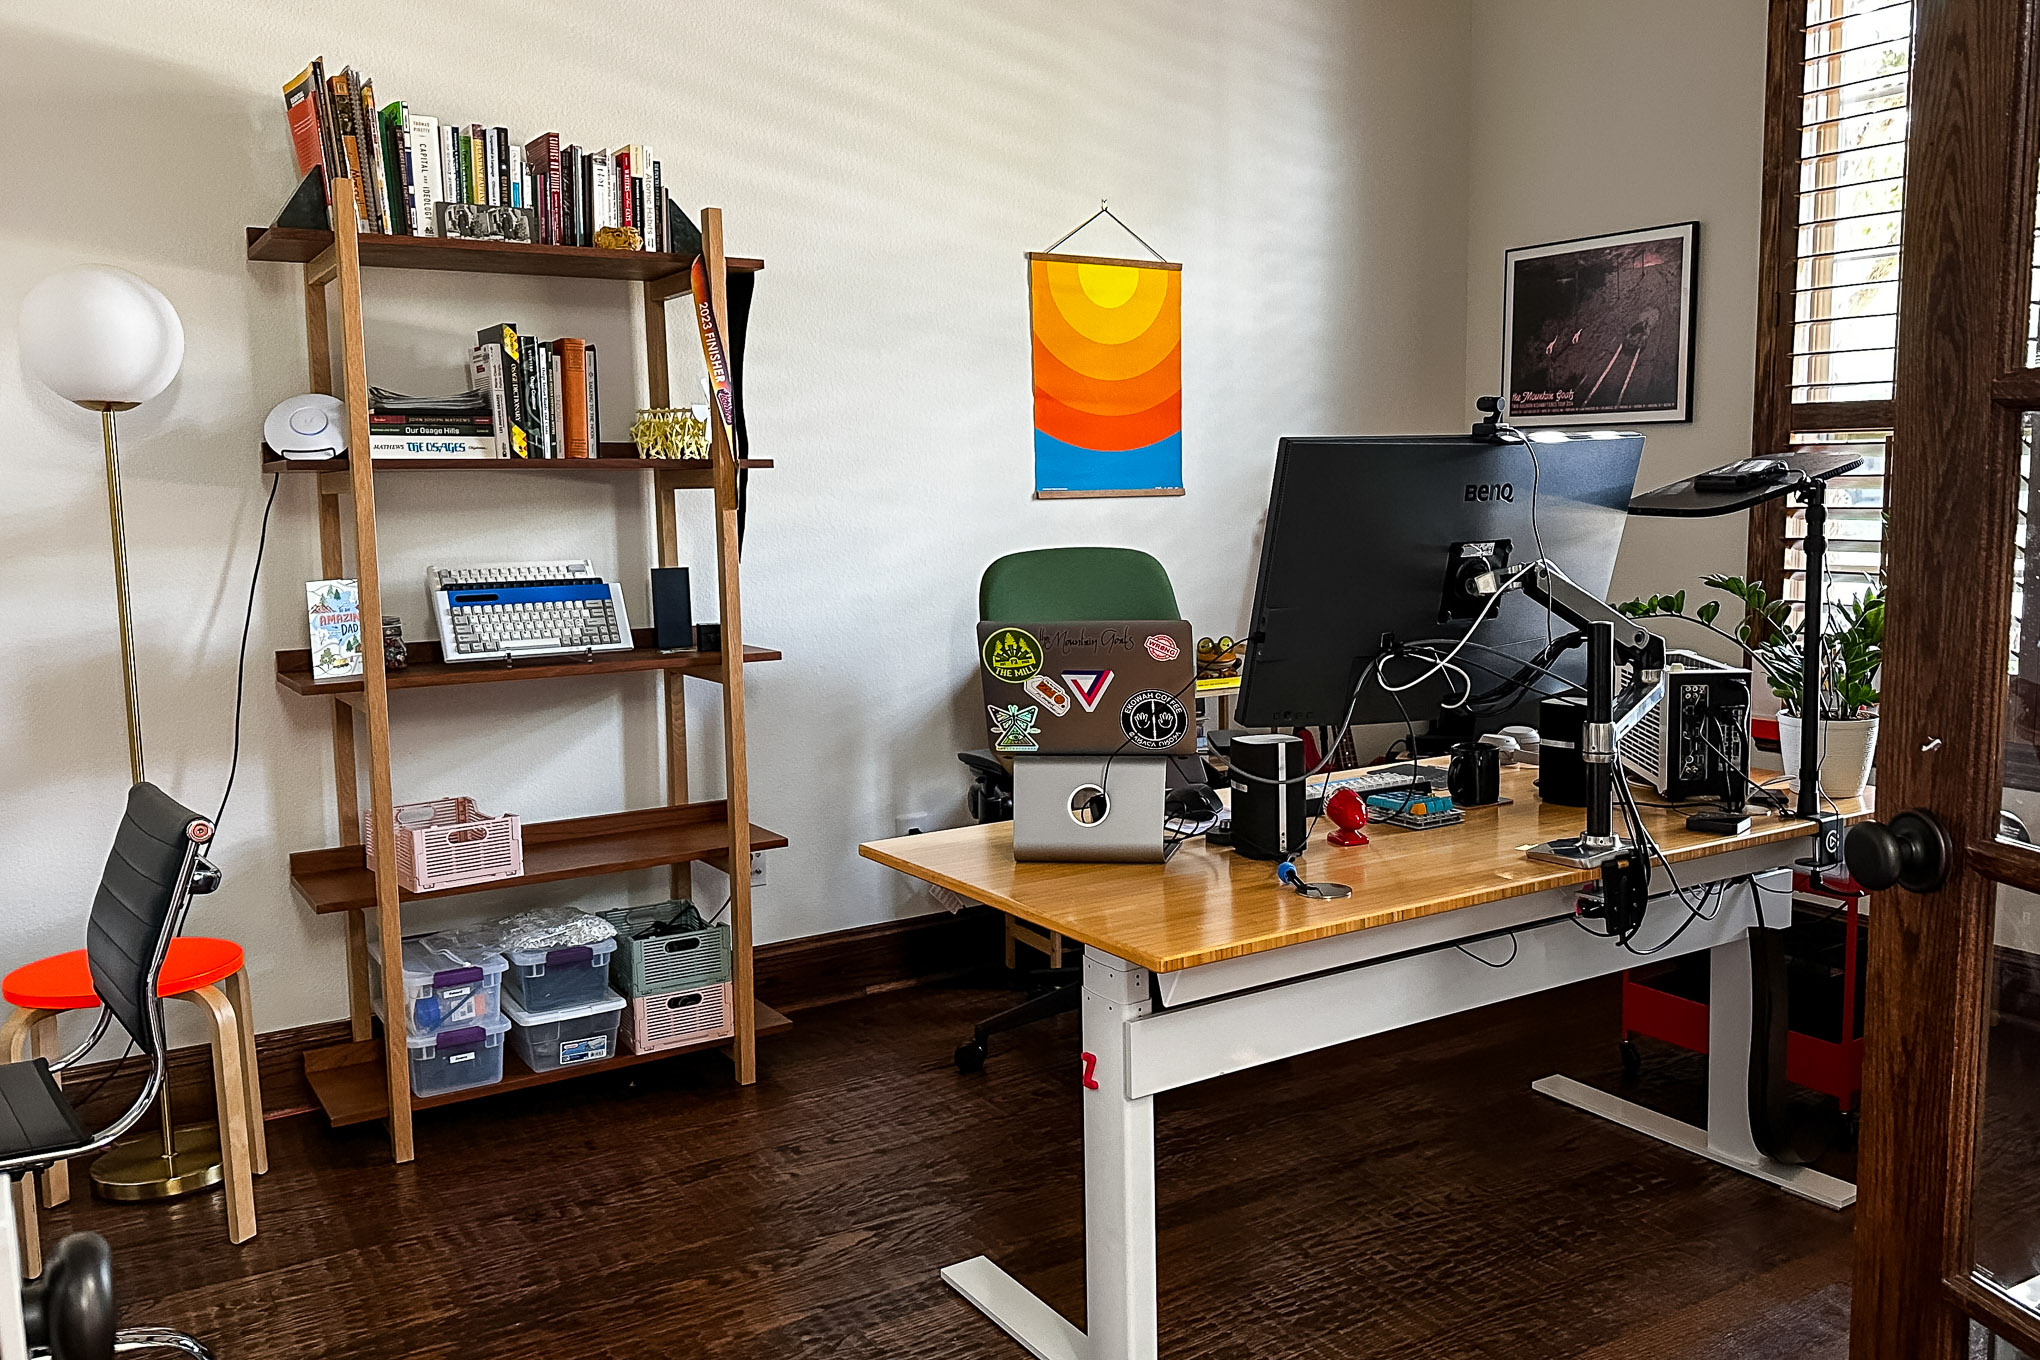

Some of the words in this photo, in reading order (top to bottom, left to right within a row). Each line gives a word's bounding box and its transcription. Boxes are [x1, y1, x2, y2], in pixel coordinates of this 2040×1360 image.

[420, 144, 429, 172] CAPITAL
[423, 187, 432, 220] IDEOLOGY
[699, 302, 712, 330] 2023
[704, 332, 726, 383] FINISHER
[512, 384, 521, 422] DICTIONARY
[1520, 390, 1554, 403] Mountain
[1556, 389, 1574, 402] Goats
[406, 442, 424, 453] THE
[426, 442, 466, 453] OSAGES
[320, 613, 360, 626] AMAZIN
[341, 624, 358, 636] DAD
[1050, 629, 1098, 654] Mountain
[1101, 626, 1135, 653] Goats
[1148, 640, 1178, 656] WRONG
[995, 667, 1013, 677] THE
[1014, 665, 1037, 677] MILL
[1124, 693, 1154, 714] EKOWAH
[1155, 693, 1182, 714] COFFEE
